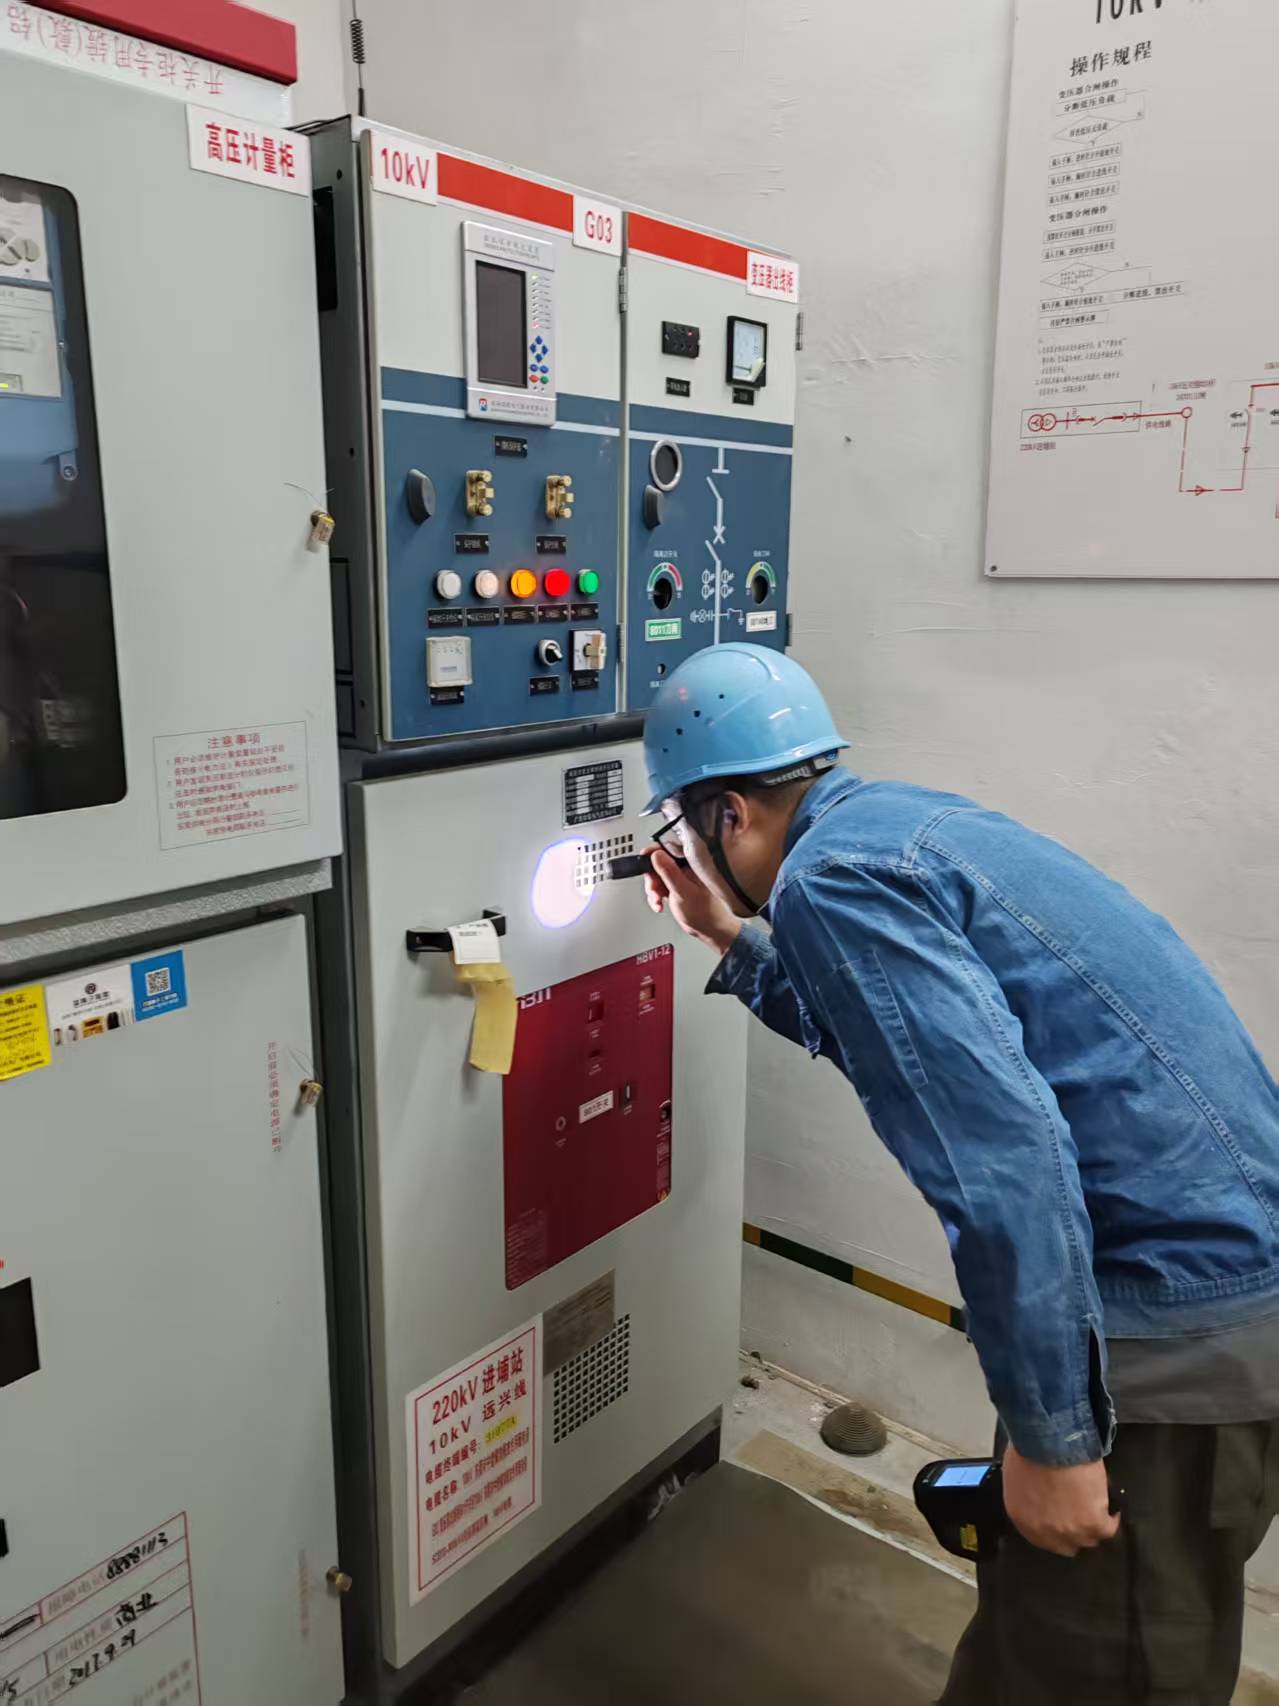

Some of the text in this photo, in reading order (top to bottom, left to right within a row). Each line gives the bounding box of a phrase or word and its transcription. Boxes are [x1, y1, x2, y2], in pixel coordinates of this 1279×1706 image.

[1070, 40, 1153, 77] 操作规程
[205, 122, 295, 178] 高压计量柜
[381, 147, 430, 189] 10kV
[584, 210, 613, 244] G03
[207, 733, 261, 749] 注意事项
[429, 1415, 471, 1454] 10kV
[482, 1378, 527, 1422] 远兴线
[432, 1375, 478, 1425] 220kV
